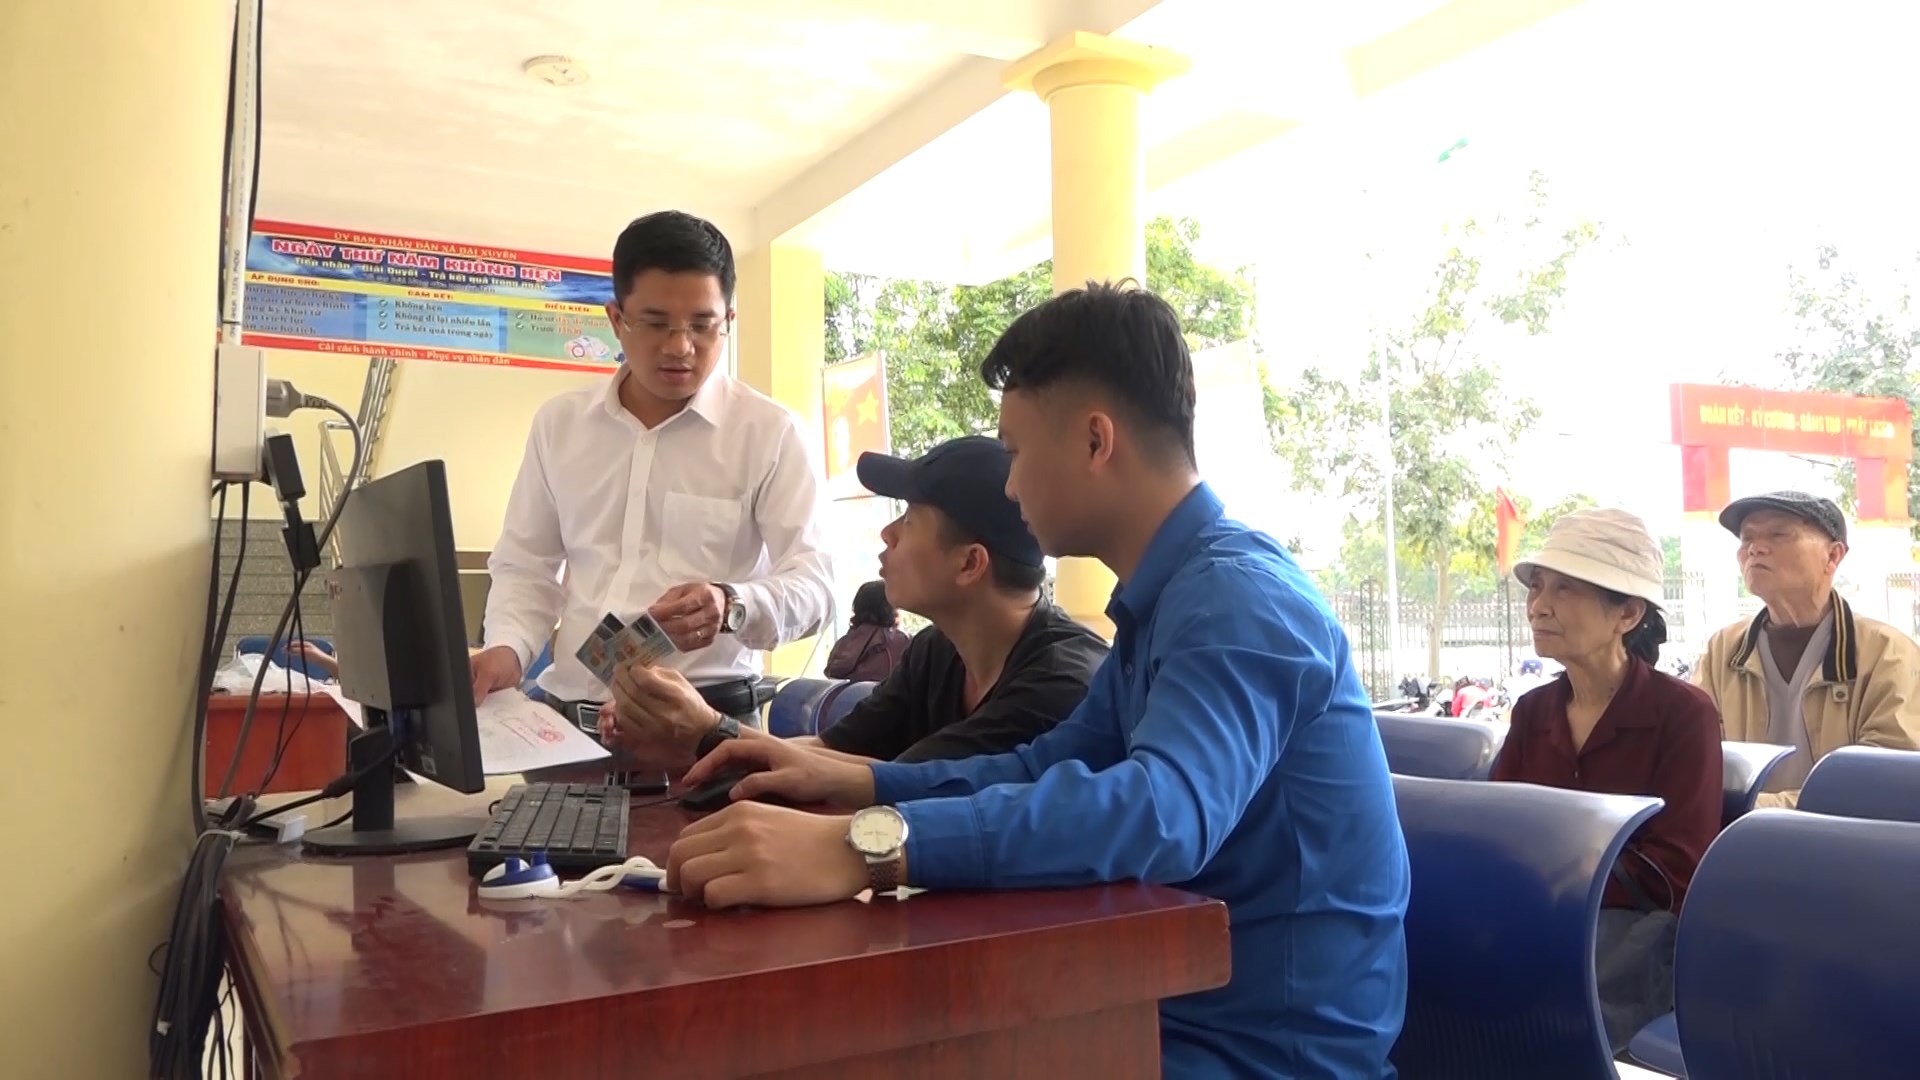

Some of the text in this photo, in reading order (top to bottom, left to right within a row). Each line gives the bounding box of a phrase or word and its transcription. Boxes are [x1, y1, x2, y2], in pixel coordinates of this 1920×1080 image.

[353, 234, 376, 244] BAN
[380, 237, 416, 248] NHÂN
[272, 238, 337, 258] NGÀY
[340, 245, 386, 264] THỨ
[388, 250, 439, 269] NĂM
[444, 257, 515, 278] KHÔNG
[520, 266, 562, 283] HẸN
[394, 299, 424, 312] Không
[394, 310, 424, 323] Không
